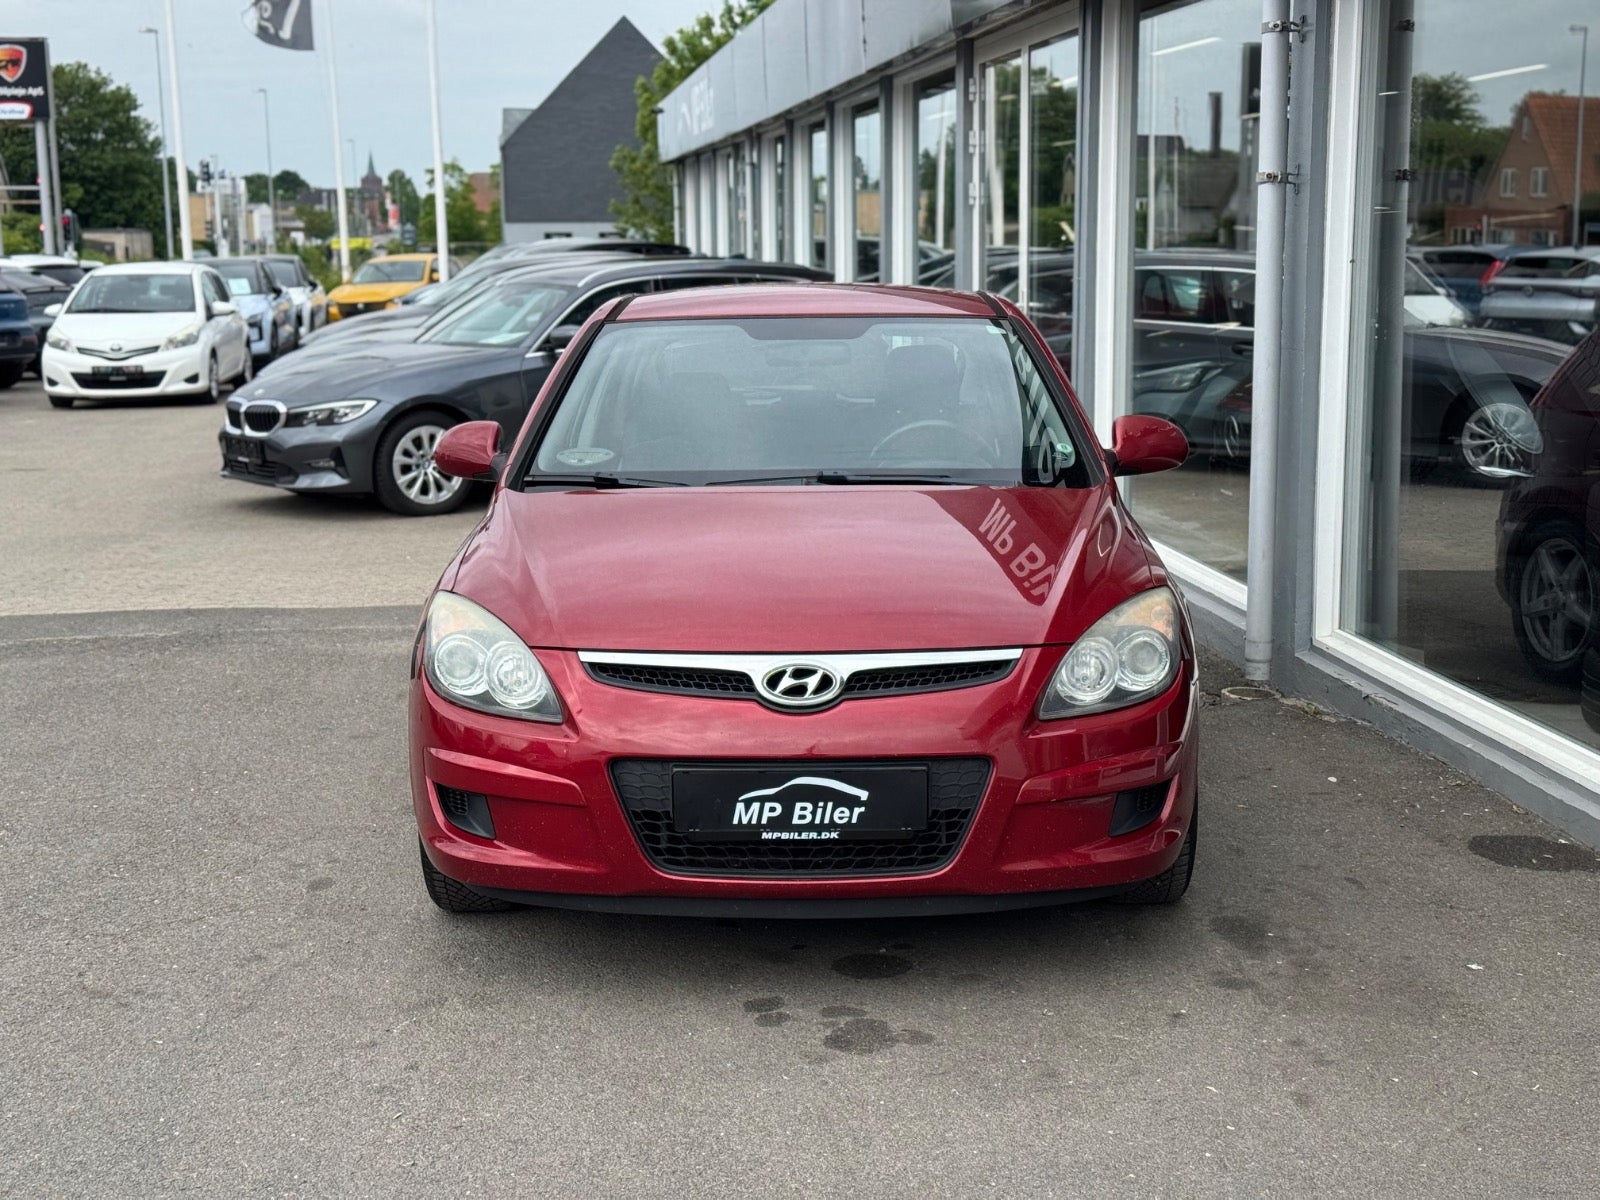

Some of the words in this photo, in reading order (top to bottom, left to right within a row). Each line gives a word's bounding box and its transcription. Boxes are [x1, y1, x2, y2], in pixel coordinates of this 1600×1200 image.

[732, 801, 782, 825] MP
[791, 801, 866, 825] Biler
[761, 831, 840, 840] MPBILER.DK
